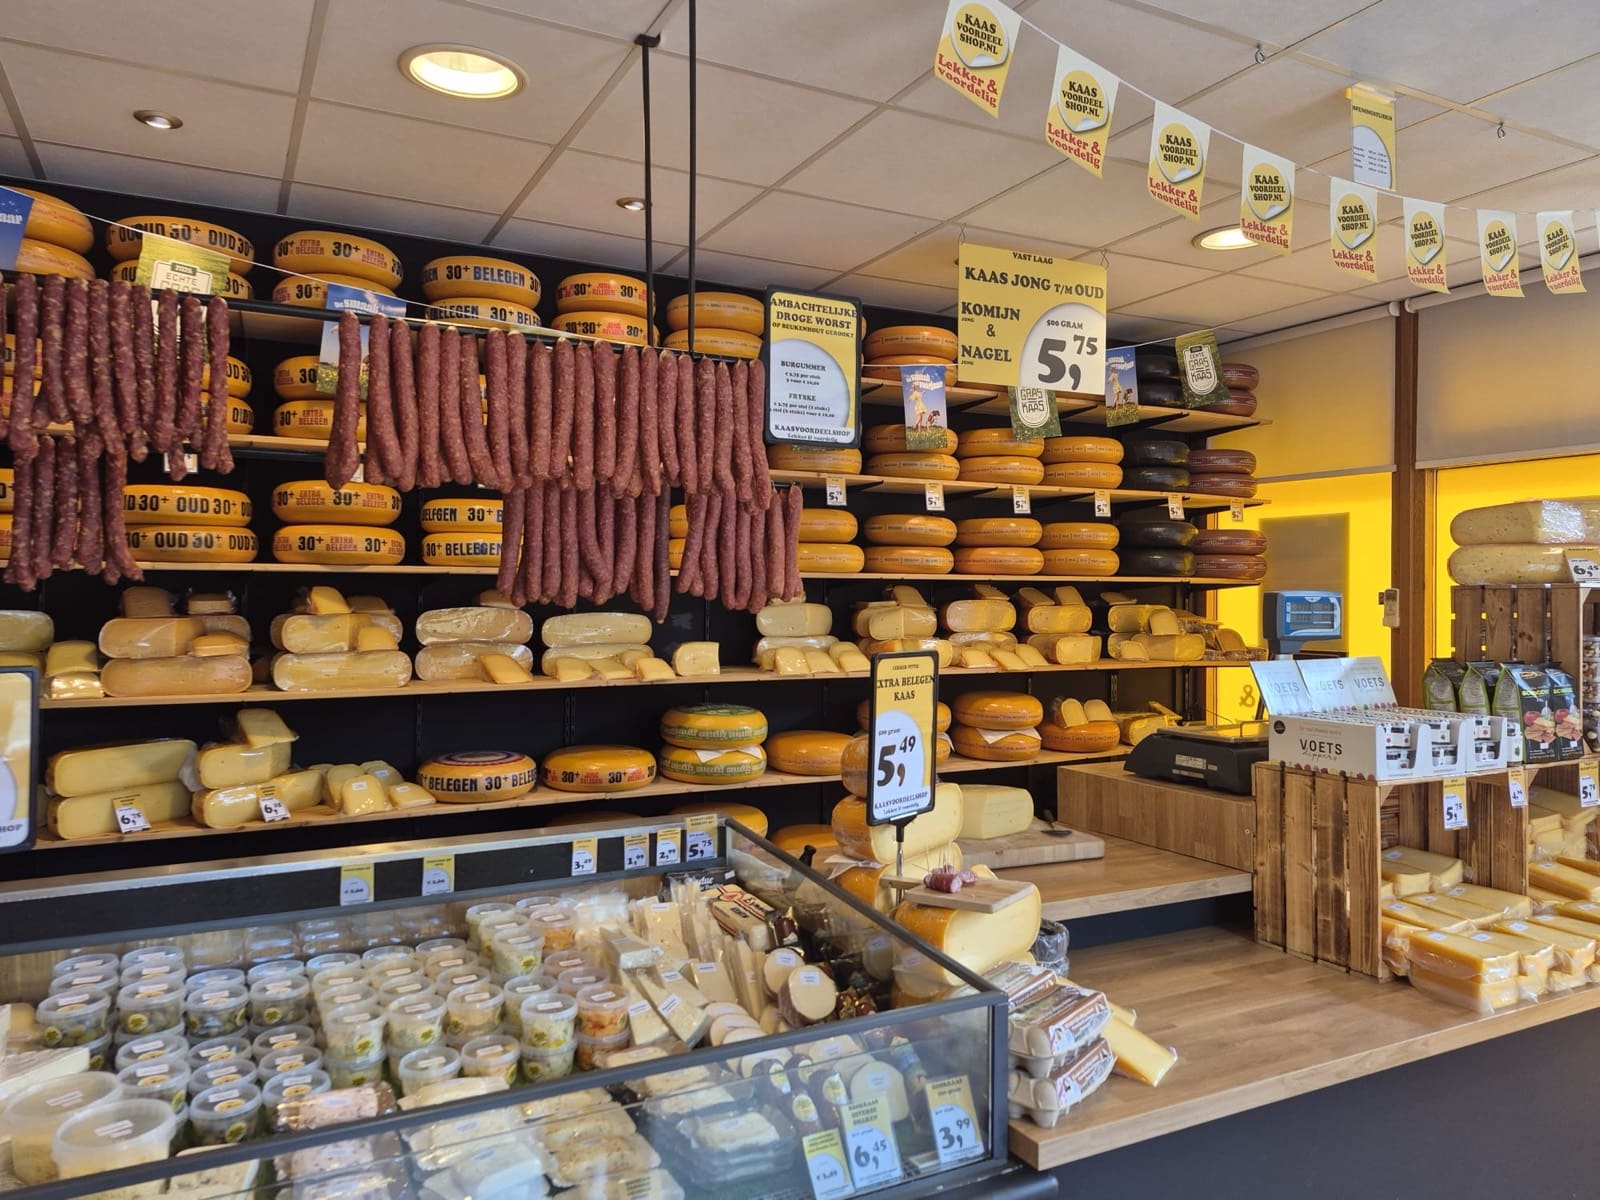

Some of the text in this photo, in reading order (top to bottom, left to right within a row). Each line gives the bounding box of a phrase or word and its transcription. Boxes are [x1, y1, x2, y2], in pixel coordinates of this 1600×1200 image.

[965, 14, 996, 34] KAAS
[957, 22, 1002, 46] VOORDEEL
[960, 33, 998, 55] SHOP.NL
[938, 53, 998, 95] Lekker &
[938, 68, 997, 108] voordelig
[1068, 81, 1097, 97] KAAS
[1062, 90, 1103, 108] VOORDEEL
[1065, 100, 1100, 117] SHOP.NL
[1048, 122, 1101, 155] Lekker &
[1166, 134, 1192, 147] KAAS
[1048, 136, 1100, 169] voordelig
[1160, 144, 1198, 157] VOORDEEL
[1163, 154, 1195, 166] SHOP.NL
[1255, 175, 1279, 184] KAAS
[1149, 177, 1198, 202] Lekker &
[1250, 185, 1286, 193] VOORDEEL
[1151, 190, 1198, 214] voordelig
[1254, 193, 1283, 202] SHOP.NL
[1342, 205, 1364, 214] KAAS
[1338, 214, 1370, 222] VOORDEEL
[1242, 218, 1288, 235] Lekker &
[1342, 222, 1368, 230] SHOP.NL
[1414, 221, 1432, 232] KAAS
[208, 229, 236, 249] OUD
[1244, 232, 1288, 248] voordelig
[332, 241, 360, 257] 30+
[1332, 249, 1373, 261] Lekker &
[1012, 252, 1053, 264] VAST LAAG
[1335, 260, 1374, 273] voordelig
[1408, 266, 1434, 275] Lekker
[446, 265, 470, 280] 30+
[473, 266, 525, 287] BELEGEN
[964, 266, 1104, 299] KAAS JONG T/M OUD
[296, 284, 320, 299] 30+
[574, 283, 638, 298] 30+ 30+
[490, 306, 514, 321] 30+
[771, 298, 857, 318] AMBACHTELIJKE
[961, 301, 1020, 320] KOMIJN
[776, 311, 851, 329] DROGE WORST
[1046, 319, 1083, 330] 500 GRAM
[626, 326, 643, 337] 30+
[826, 329, 854, 338] GEROOKT
[986, 323, 996, 337] &
[961, 344, 1012, 362] NAGEL
[780, 360, 826, 372] BURGUMMER
[1188, 357, 1209, 371] GRAS
[1191, 369, 1212, 382] KAAS
[788, 393, 816, 402] FRYSKE
[1020, 388, 1043, 400] GRAS
[1022, 400, 1044, 413] KAAS
[280, 410, 298, 426] 30+
[775, 424, 851, 437] KAASVOORDEELSHOP
[138, 495, 237, 515] 30+ OUD 30+
[333, 490, 361, 506] 30+
[467, 508, 494, 522] 30+
[154, 532, 188, 548] OUD
[192, 533, 222, 549] 30+
[298, 536, 324, 551] 30+
[364, 538, 388, 552] 30+
[877, 674, 935, 690] XTRA BELEGEN
[1354, 677, 1385, 689] VOETS
[894, 690, 915, 701] KAAS
[1300, 739, 1342, 756] VOETS
[428, 776, 509, 792] BELEGEN 30+
[561, 770, 580, 784] 30+
[608, 770, 628, 784] 30+
